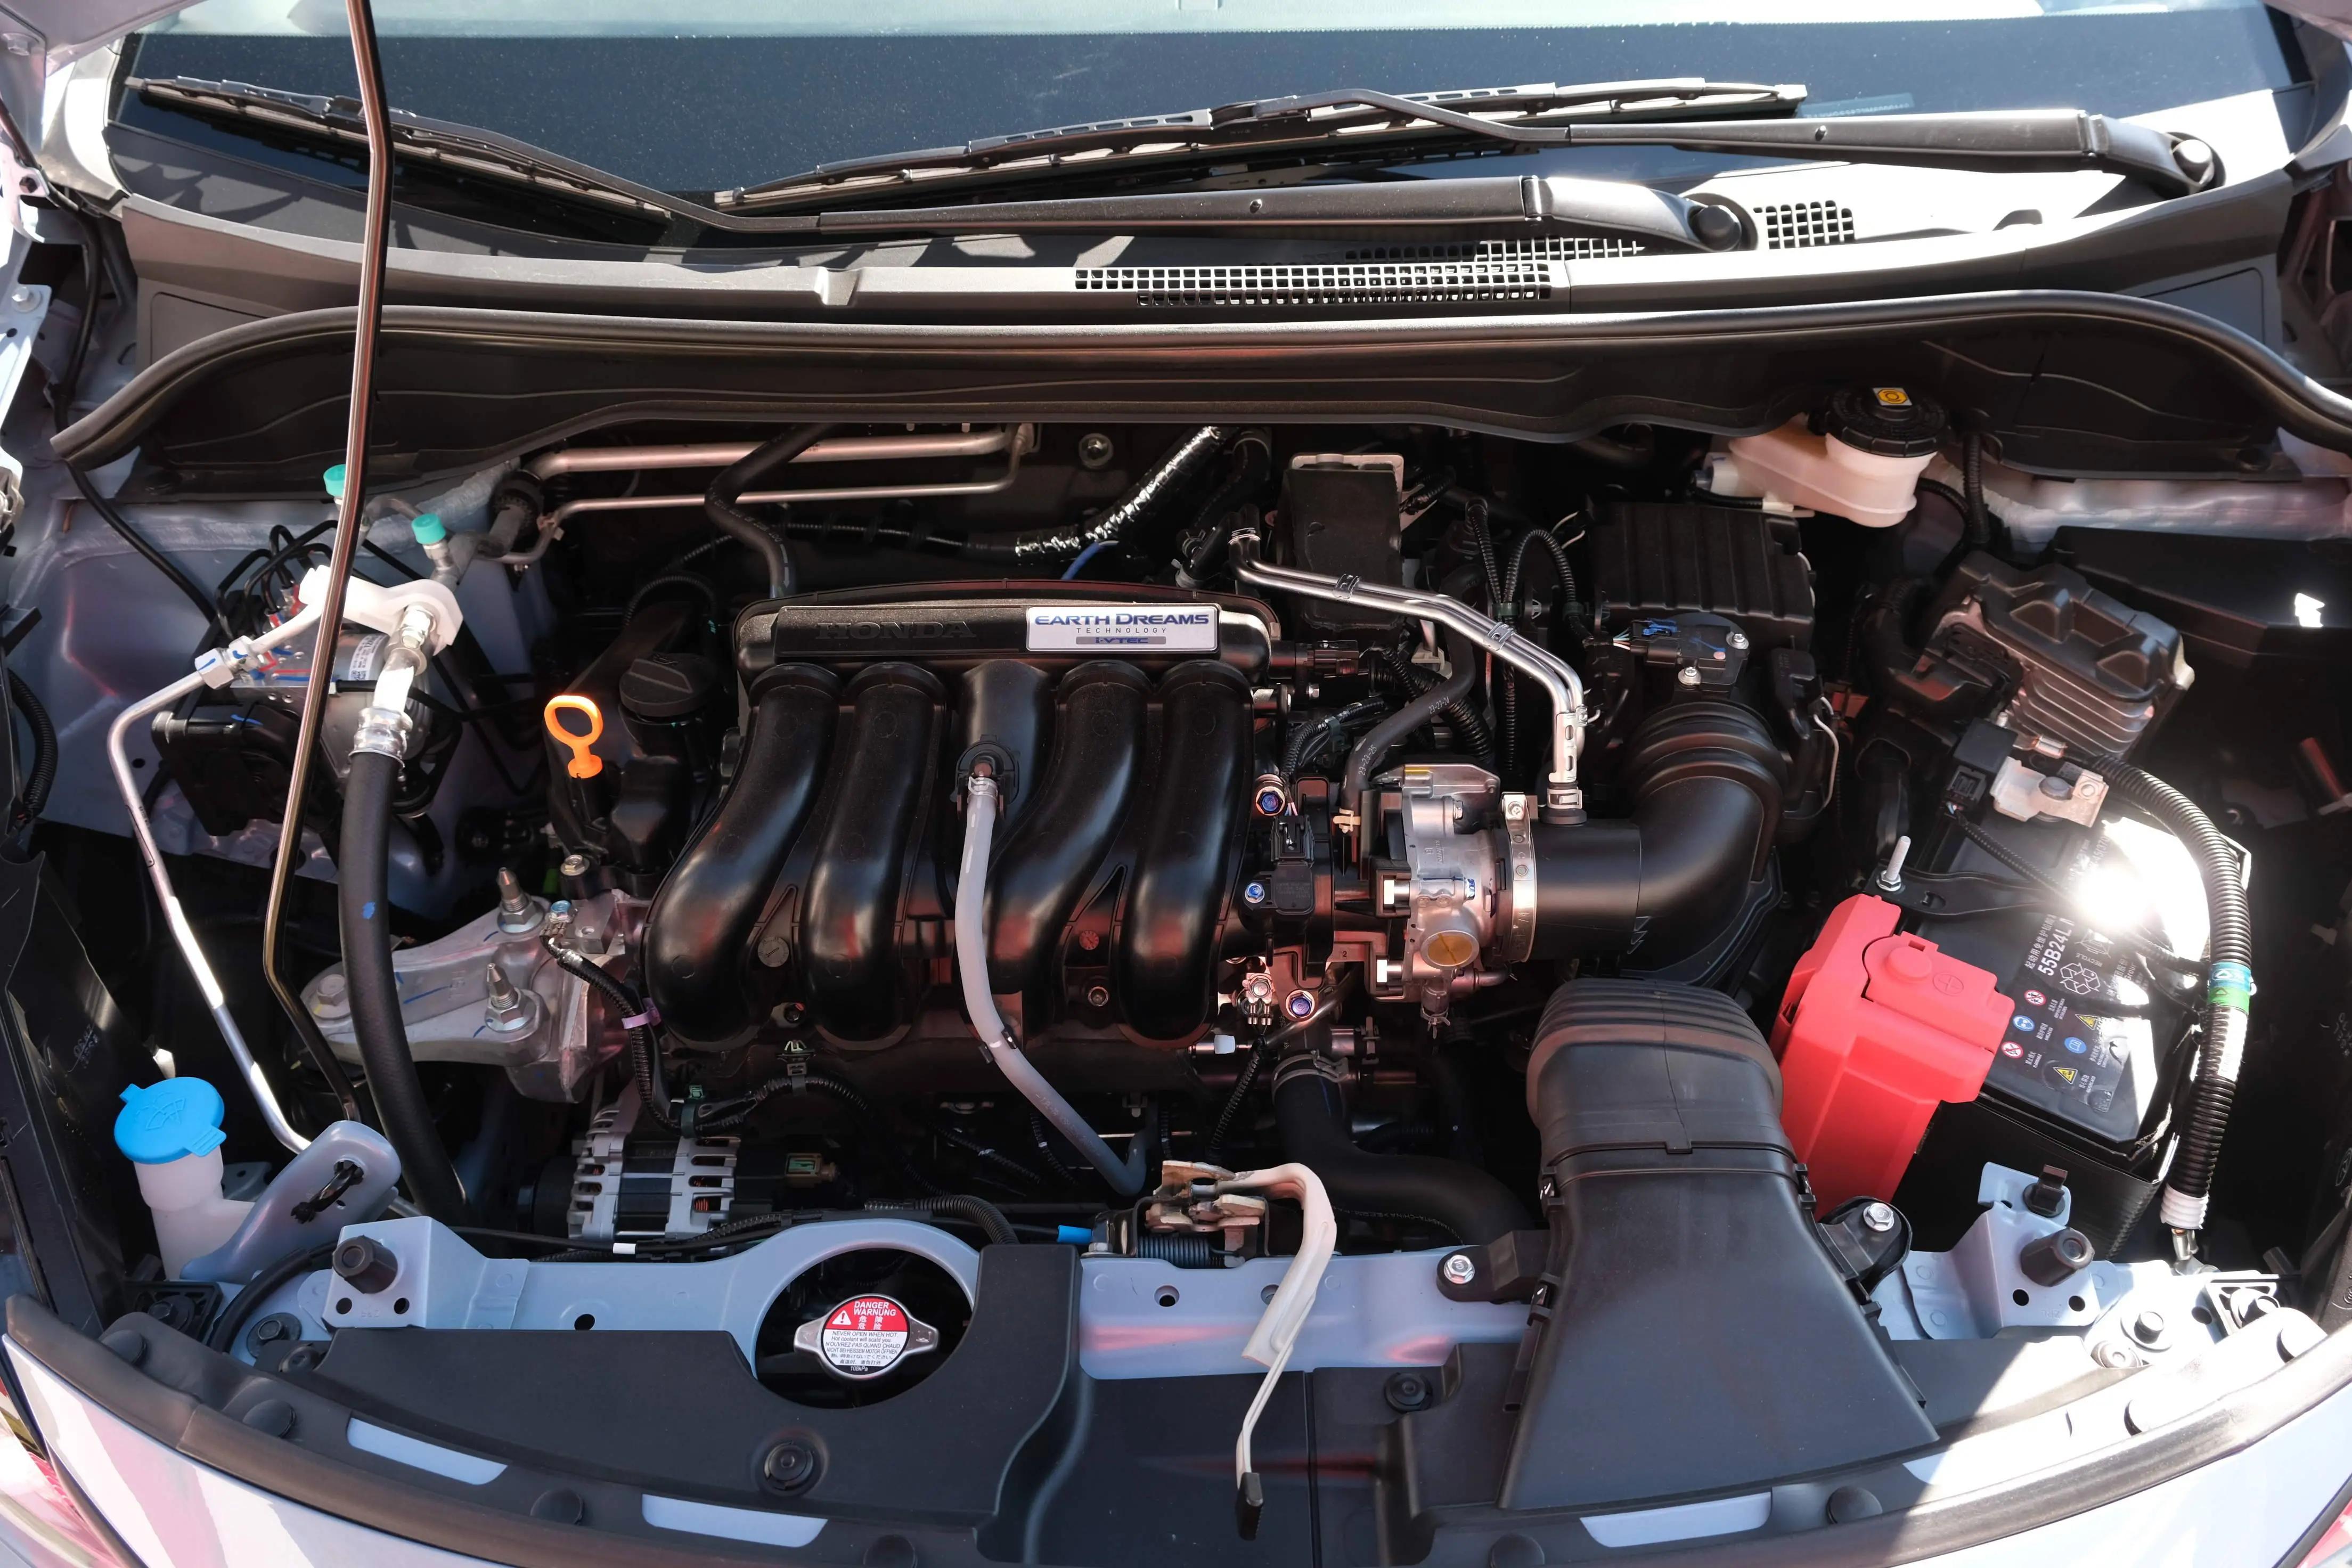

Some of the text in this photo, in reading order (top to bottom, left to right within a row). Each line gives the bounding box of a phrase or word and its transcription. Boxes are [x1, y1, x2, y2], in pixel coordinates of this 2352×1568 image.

[1035, 613, 1210, 625] EARTH DREAMS
[816, 620, 977, 639] HONDA
[2037, 928, 2072, 976] 55B24L
[2075, 952, 2103, 967] RECYCLE
